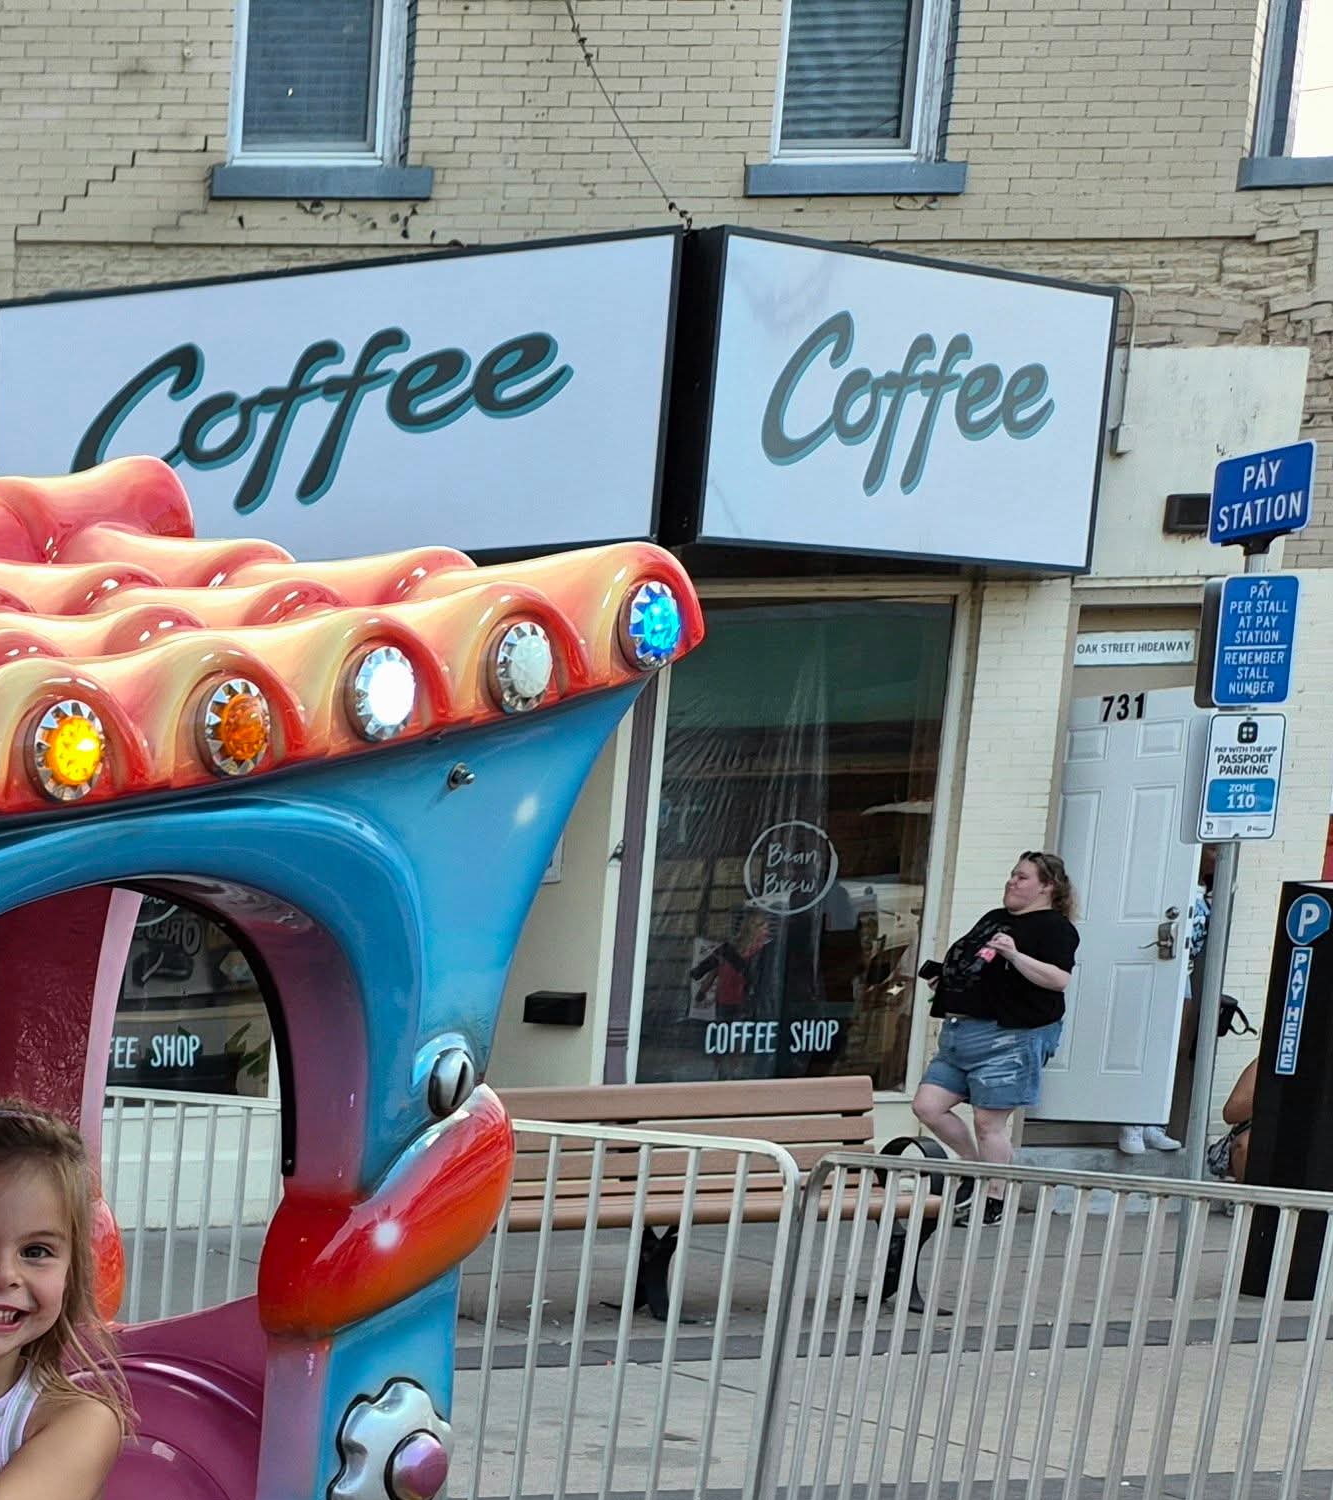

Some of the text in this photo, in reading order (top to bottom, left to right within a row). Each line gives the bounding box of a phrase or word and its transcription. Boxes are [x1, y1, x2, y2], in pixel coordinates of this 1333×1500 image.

[761, 309, 1055, 497] Coffee
[70, 326, 574, 515] Coffee
[1242, 458, 1282, 493] PAY
[1217, 490, 1303, 533] STATION
[1249, 584, 1273, 599] PAY
[1229, 600, 1289, 615] PER STALL
[1238, 615, 1279, 629] AT PAY
[1234, 630, 1279, 644] STATION
[1076, 640, 1191, 654] OAK STREET HIDEAWAY
[1223, 651, 1285, 665] REMEMBER
[1236, 666, 1269, 680] STALL
[1228, 681, 1275, 695] NUMBER
[1102, 692, 1145, 722] 731
[1217, 753, 1273, 764] PASSPORT
[1219, 764, 1269, 775] PARKING
[1228, 783, 1255, 793] ZONE
[1226, 793, 1256, 809] 110
[766, 842, 818, 868] Bean
[763, 872, 816, 896] Brew
[1297, 903, 1321, 938] P
[1280, 952, 1308, 1069] PAY HERE
[705, 1019, 840, 1055] COFFEE SHOP
[150, 1034, 201, 1068] SHOP
